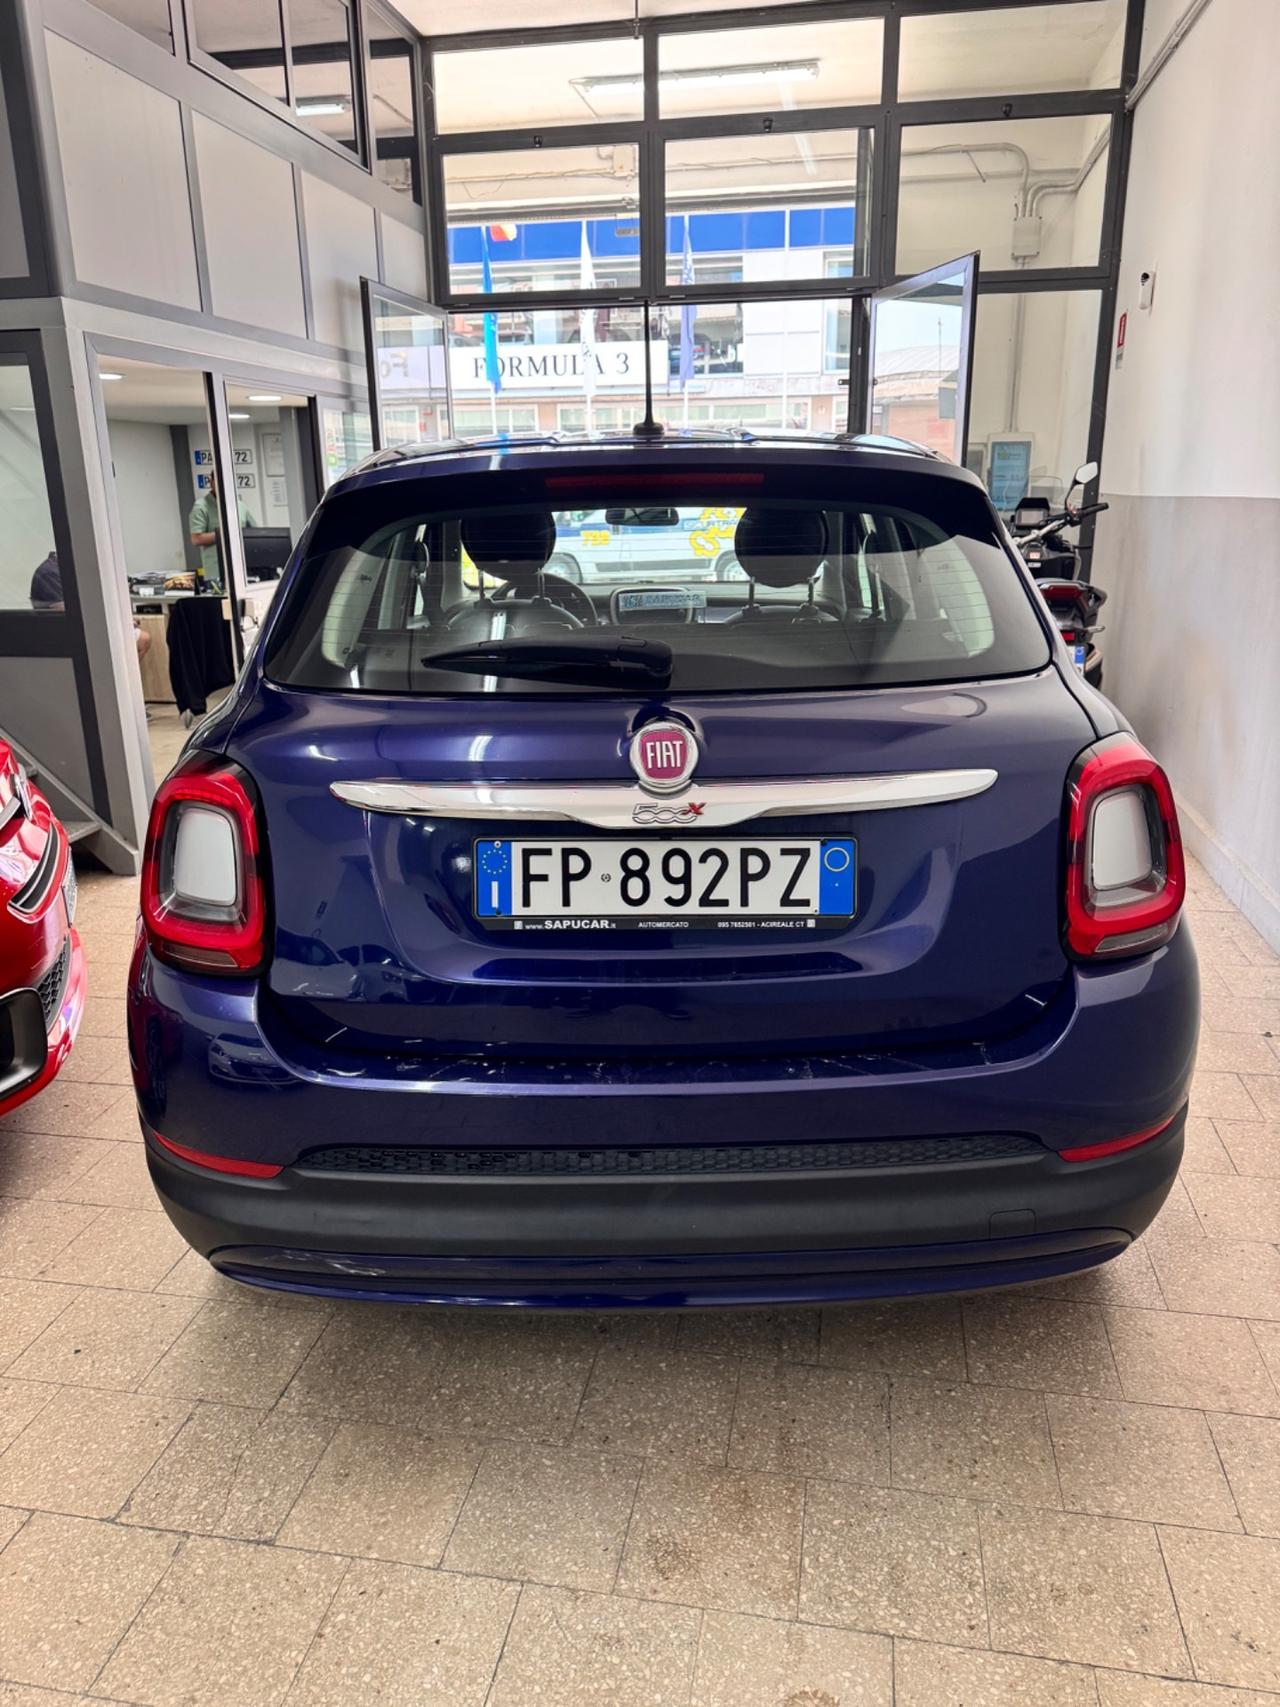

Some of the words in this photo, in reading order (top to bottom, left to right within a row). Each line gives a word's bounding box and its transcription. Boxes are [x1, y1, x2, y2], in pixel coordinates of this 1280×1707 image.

[616, 352, 630, 374] 3
[646, 741, 683, 769] FIAT
[522, 848, 592, 908] FP
[619, 847, 811, 908] 892PZ
